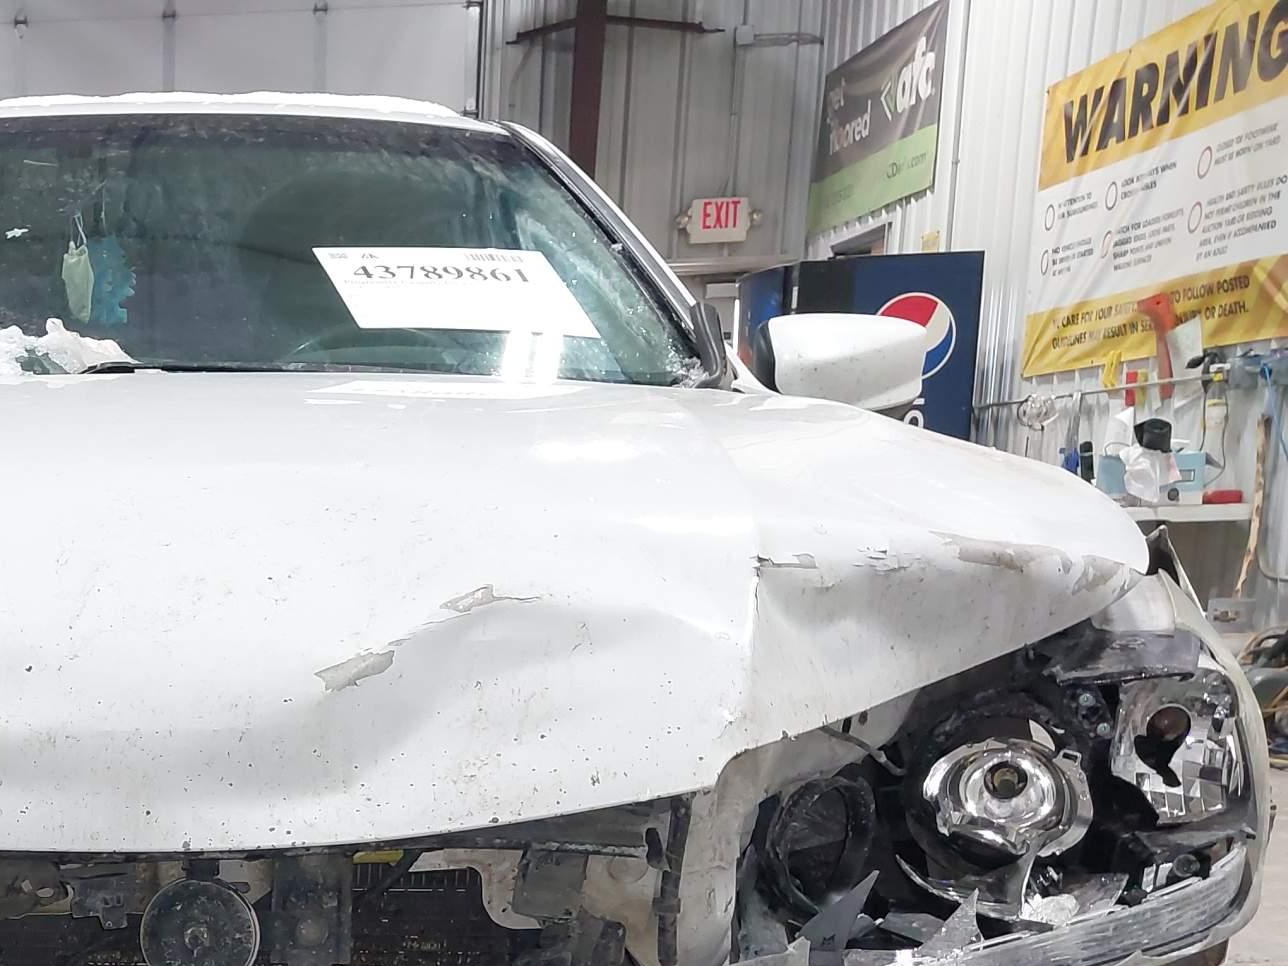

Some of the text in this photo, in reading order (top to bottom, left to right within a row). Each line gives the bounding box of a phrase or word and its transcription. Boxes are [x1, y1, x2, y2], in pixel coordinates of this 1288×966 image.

[1064, 0, 1288, 163] WARNING
[702, 200, 741, 230] EXIT
[353, 265, 529, 283] 43789861
[1216, 274, 1250, 295] POSTED
